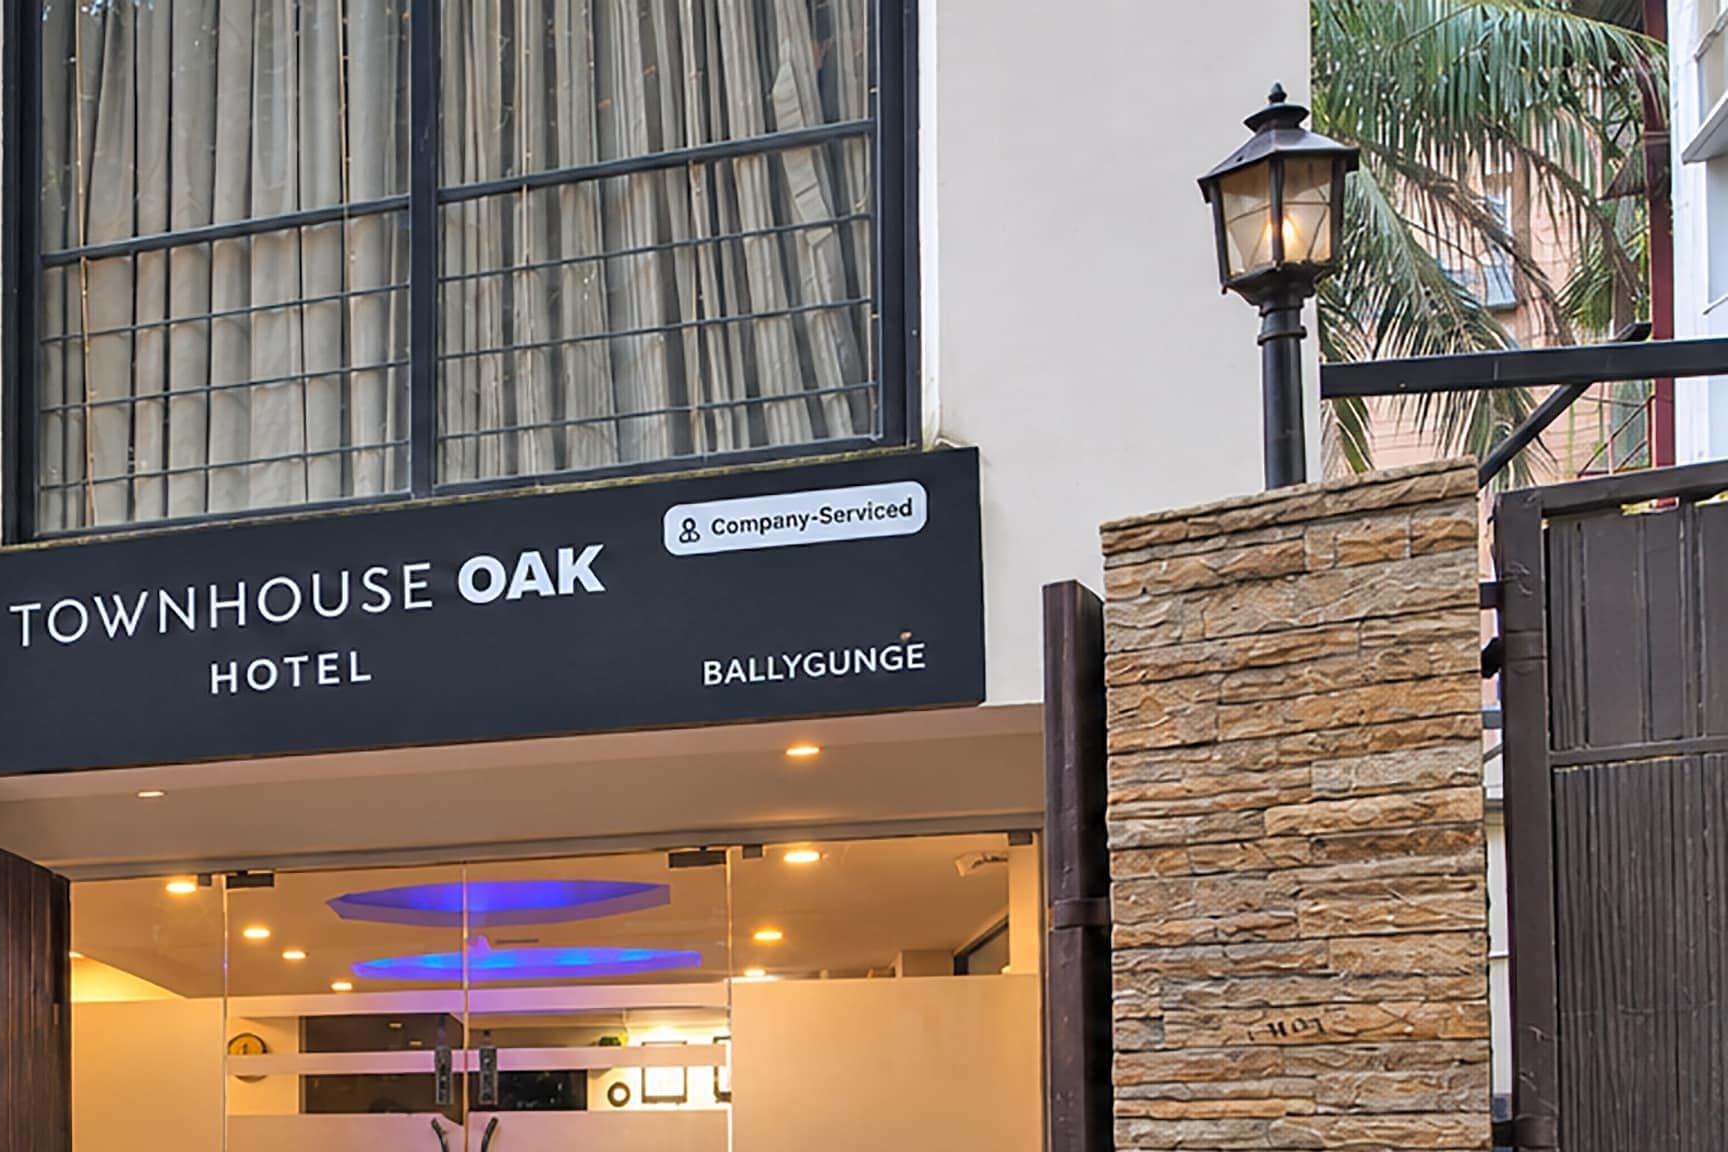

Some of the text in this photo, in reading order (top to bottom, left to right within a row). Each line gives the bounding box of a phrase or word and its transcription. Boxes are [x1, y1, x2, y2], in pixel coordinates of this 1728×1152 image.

[711, 497, 913, 536] Company-Serviced
[9, 544, 606, 647] TOWNHOUSE OAK
[211, 650, 372, 697] HOTEL
[703, 643, 927, 686] BALLYGUNGE
